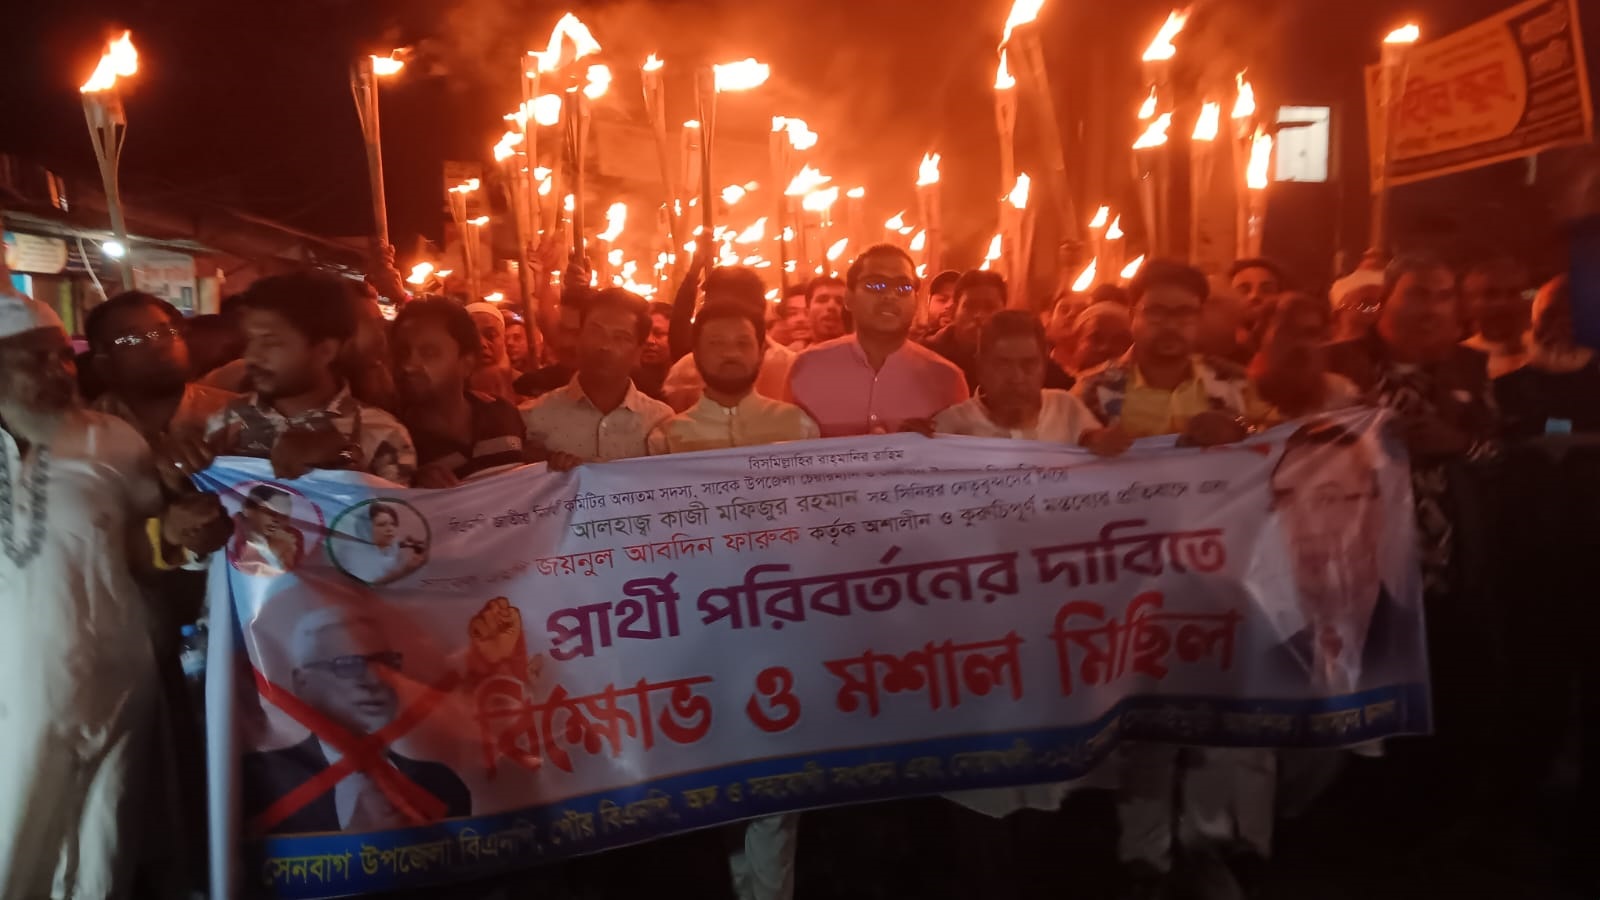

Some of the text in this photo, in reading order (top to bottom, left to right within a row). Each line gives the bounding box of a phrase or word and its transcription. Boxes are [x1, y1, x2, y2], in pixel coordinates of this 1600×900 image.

[564, 491, 606, 513] কমিটির
[611, 488, 655, 505] অন্যতম
[660, 483, 697, 500] সদস্য,
[702, 478, 740, 496] সাবেক
[744, 472, 796, 490] উপজেলা
[660, 502, 709, 529] কাজী
[719, 496, 789, 522] মফিজুর
[794, 489, 859, 512] রহমান
[866, 491, 889, 504] সহ
[894, 482, 945, 500] সিনিয়র
[535, 548, 615, 576] জয়নুল
[624, 533, 713, 563] আবদিন
[723, 526, 801, 552] ফারুক
[807, 517, 856, 546] কর্তৃক
[861, 509, 931, 534] অশালীন
[940, 511, 953, 525] ও
[546, 519, 1228, 660] প্রার্থী পরিবর্তনের দাবিতে
[474, 592, 1241, 774] বিক্ষোভ ও মশাল মিছিল
[264, 848, 351, 886] সেনবাগ
[359, 837, 451, 876] উপজেলা
